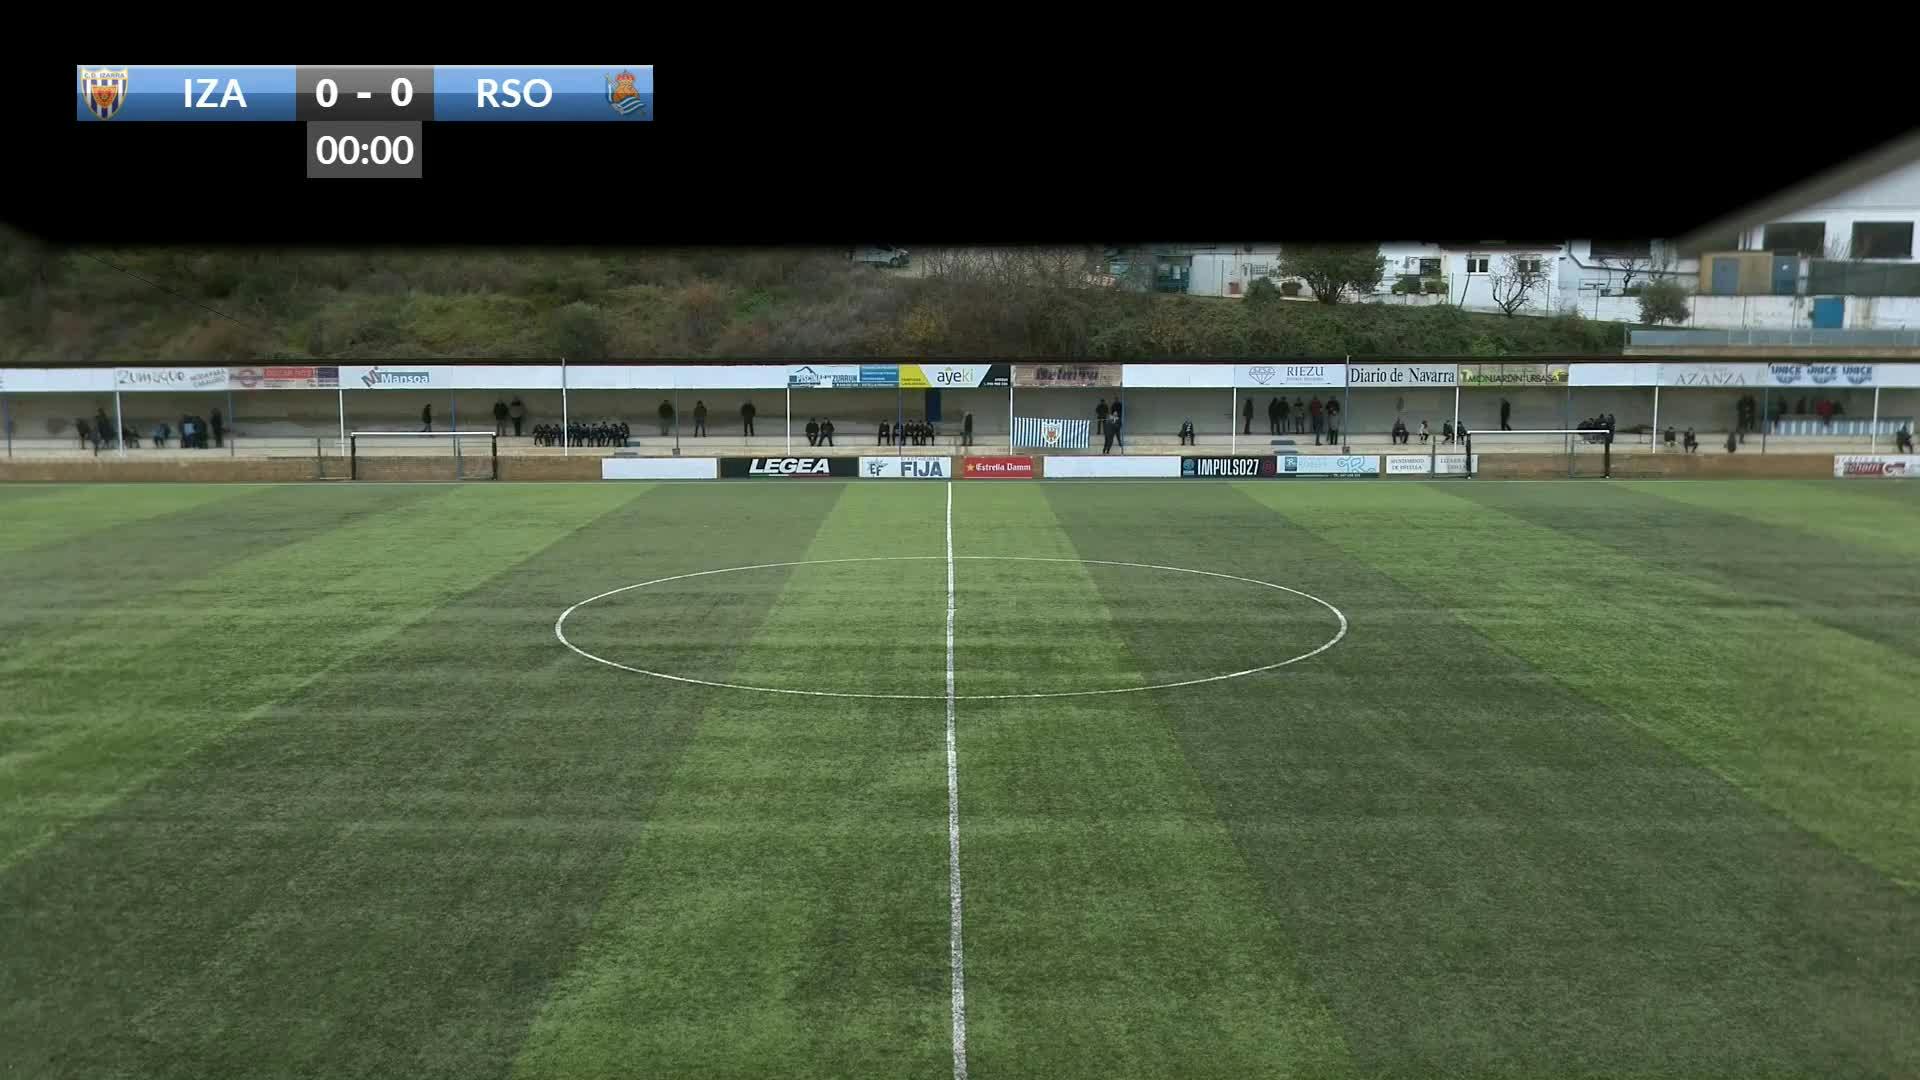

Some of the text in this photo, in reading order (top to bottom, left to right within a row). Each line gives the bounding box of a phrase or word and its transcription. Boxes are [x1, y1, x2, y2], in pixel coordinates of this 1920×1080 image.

[381, 373, 429, 384] Mansoa
[936, 368, 975, 385] ayeki
[1286, 366, 1324, 377] RIEZU
[1350, 367, 1455, 383] Diario de Navarra
[1675, 373, 1745, 385] AZANZA
[748, 457, 831, 474] LEGEA
[901, 461, 944, 477] FIJA
[975, 462, 1032, 472] Estrella Damm
[1197, 458, 1260, 476] IMPULSO27
